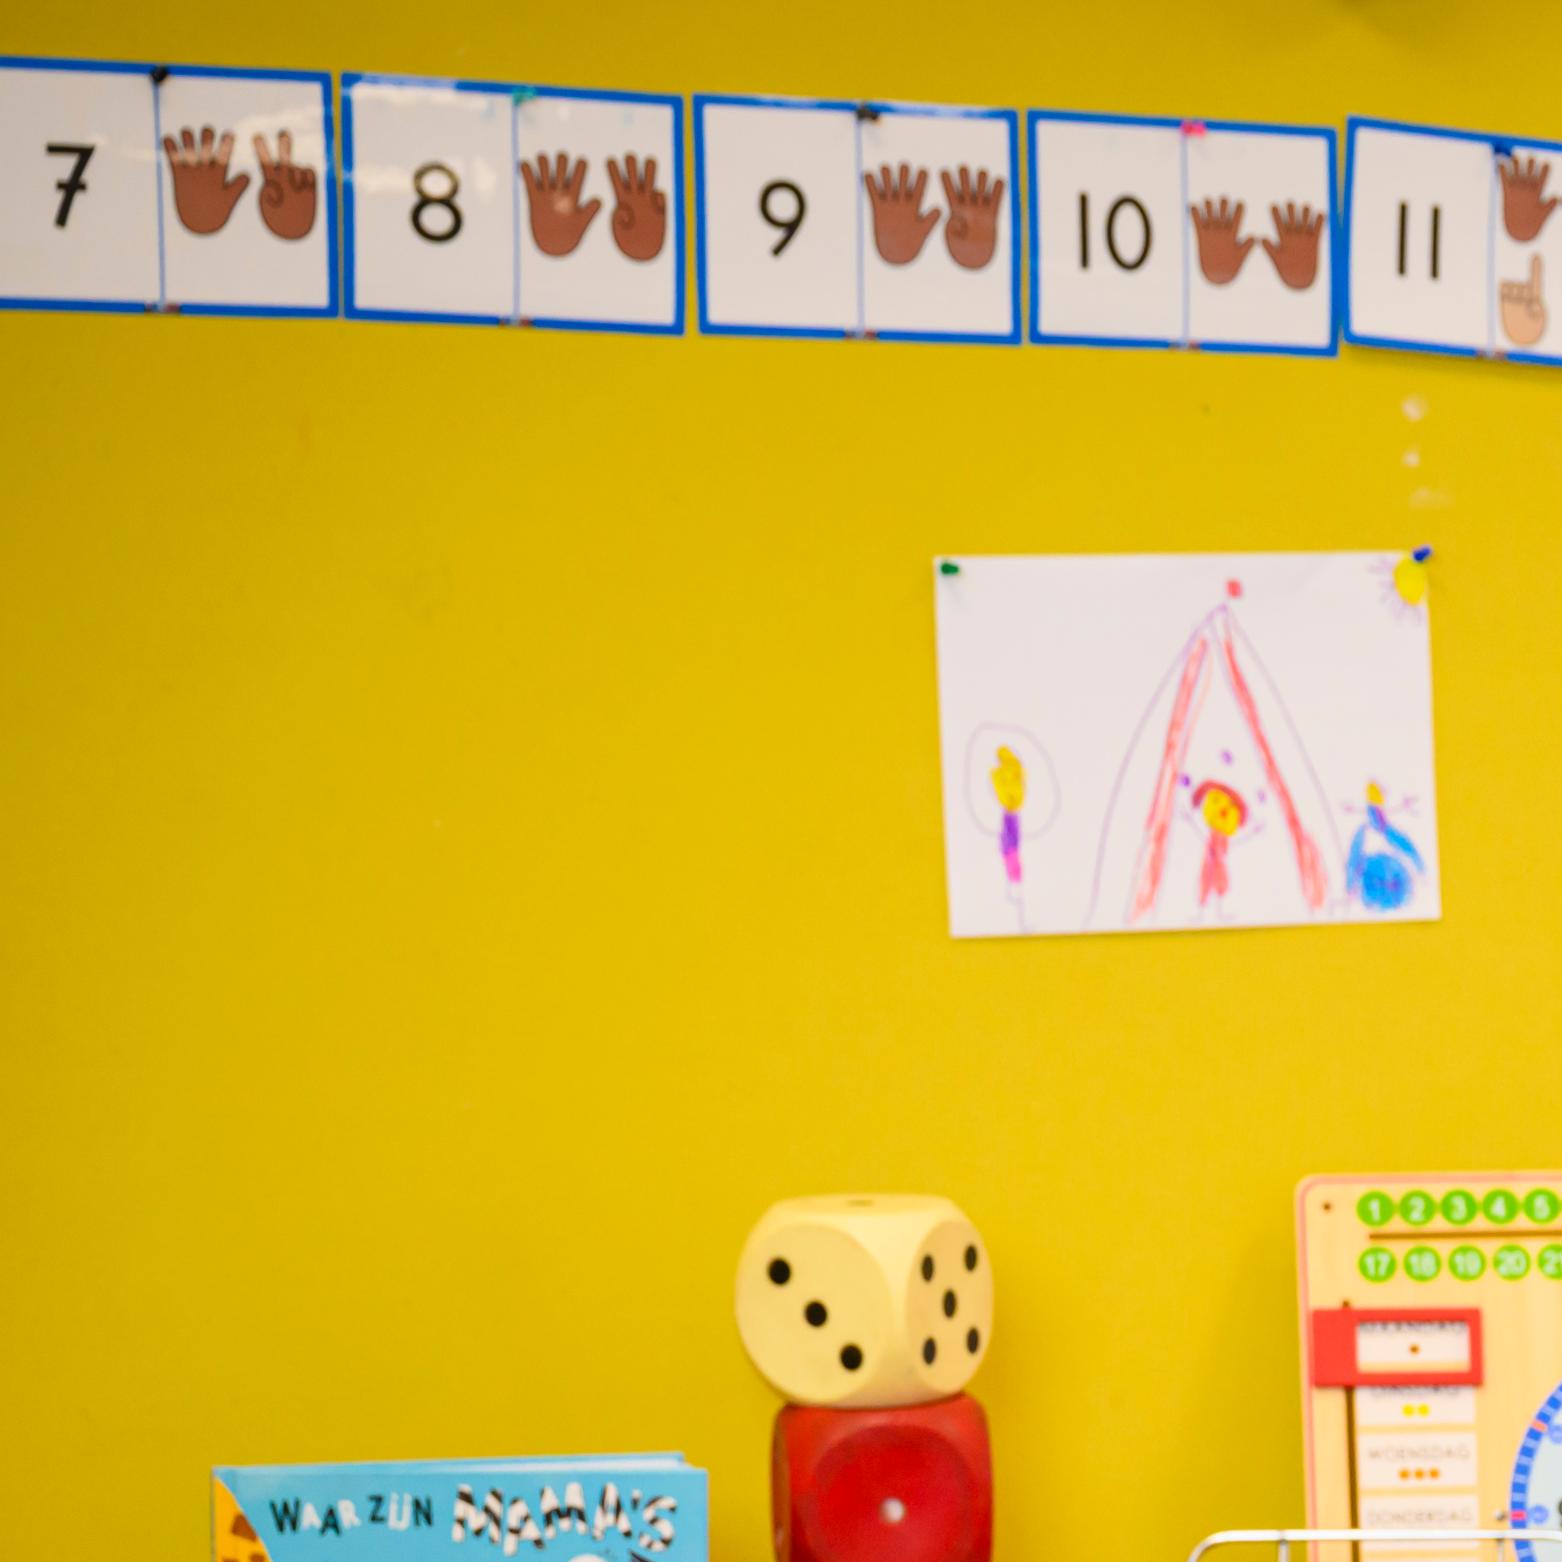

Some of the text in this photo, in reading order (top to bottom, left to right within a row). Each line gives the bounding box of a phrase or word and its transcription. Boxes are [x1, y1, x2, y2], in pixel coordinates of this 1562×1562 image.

[46, 143, 95, 228] 7
[410, 163, 463, 243] 8
[759, 180, 806, 257] 9
[1079, 193, 1152, 271] 10
[1397, 202, 1440, 279] 11
[1370, 1199, 1381, 1220] 1
[1410, 1199, 1425, 1220] 2
[1451, 1198, 1466, 1219] 3
[1492, 1198, 1507, 1218] 4
[1535, 1197, 1549, 1218] 5
[1366, 1253, 1389, 1275] 17
[1410, 1252, 1436, 1274] 18
[1456, 1252, 1480, 1273] 19
[1501, 1252, 1525, 1273] 20
[270, 1497, 361, 1537] WAAR
[451, 1482, 678, 1556] MAMA'S
